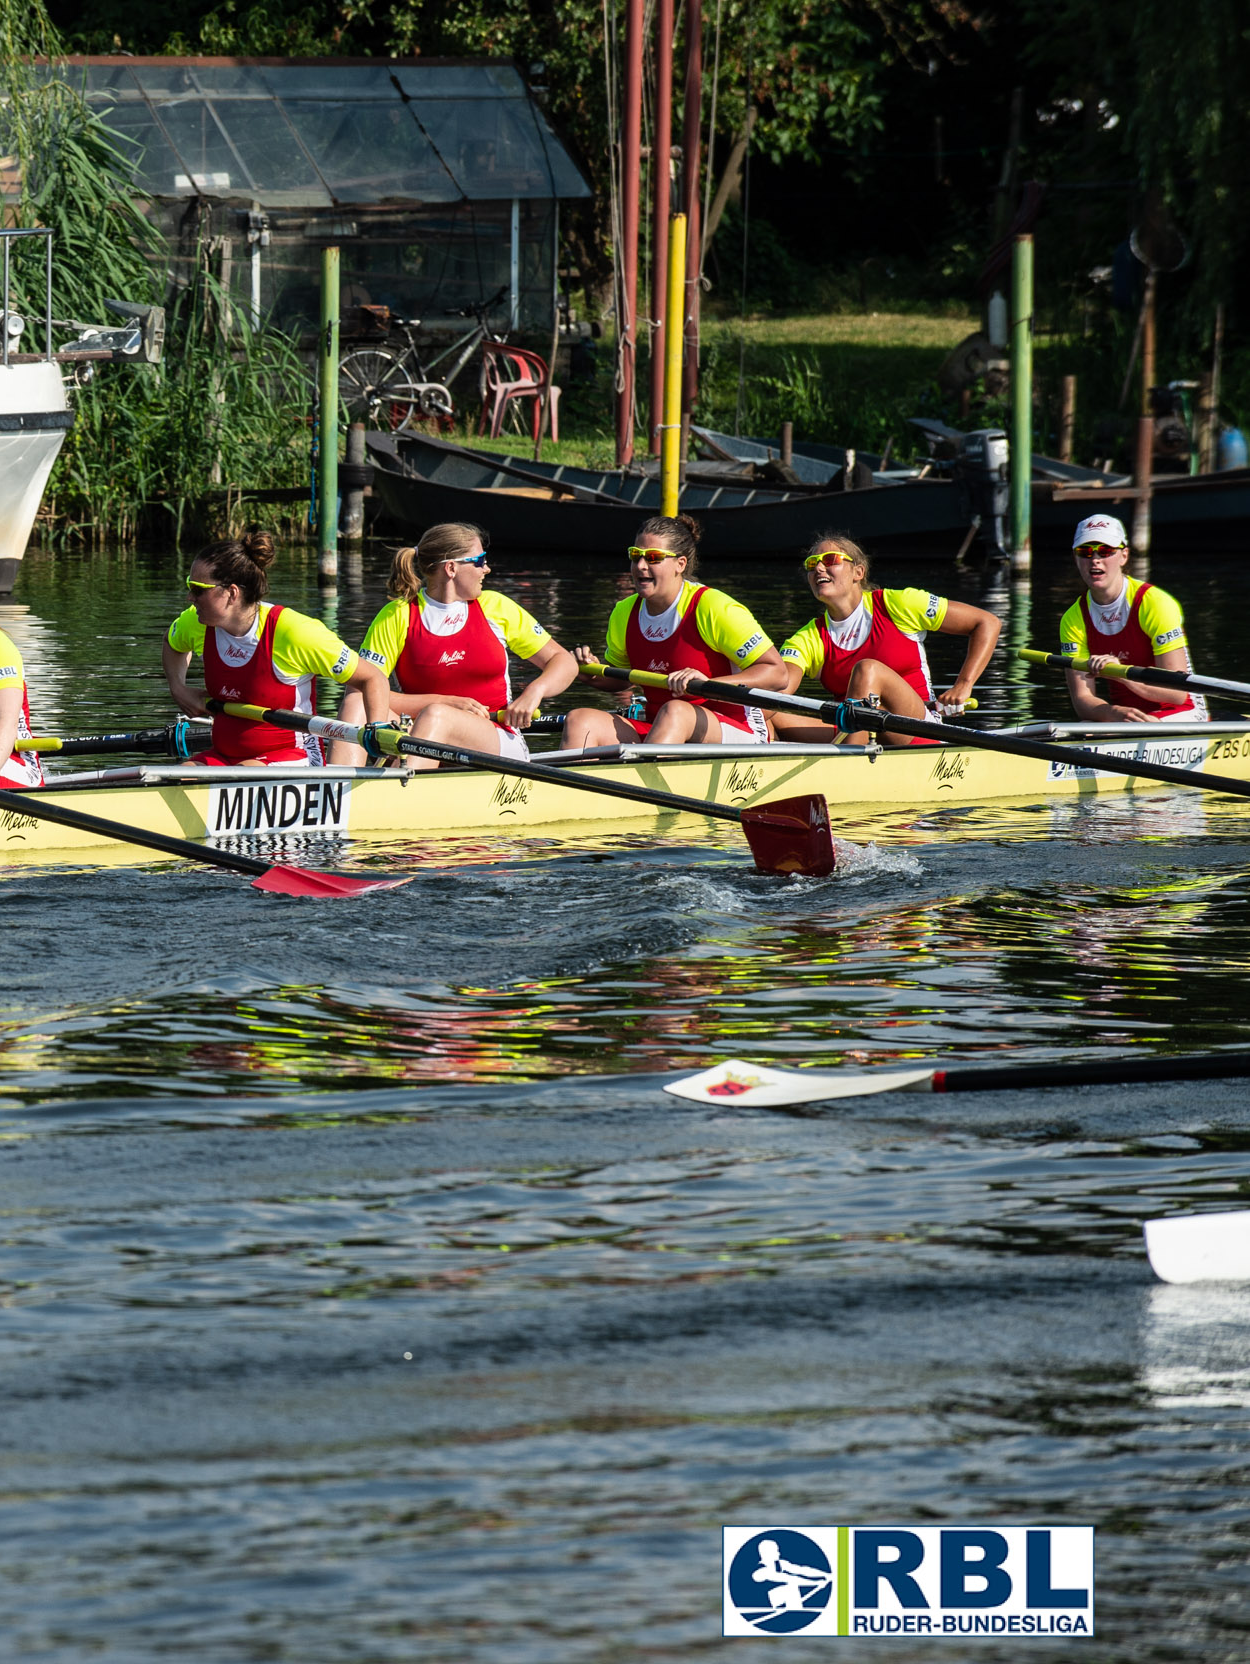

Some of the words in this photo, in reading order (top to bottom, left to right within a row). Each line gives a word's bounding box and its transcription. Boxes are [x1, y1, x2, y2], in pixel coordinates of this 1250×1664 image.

[744, 634, 762, 651] RBL
[339, 647, 349, 665] RBL
[365, 650, 384, 665] RBL
[401, 743, 418, 754] STARK.
[419, 746, 442, 758] SCHNELL.
[442, 751, 454, 760] GUT.
[1212, 741, 1221, 759] Z
[1223, 740, 1239, 758] BS
[929, 749, 964, 781] Melitta
[721, 761, 758, 793] Melitta
[489, 774, 530, 807] Melitta
[216, 782, 343, 830] MINDEN
